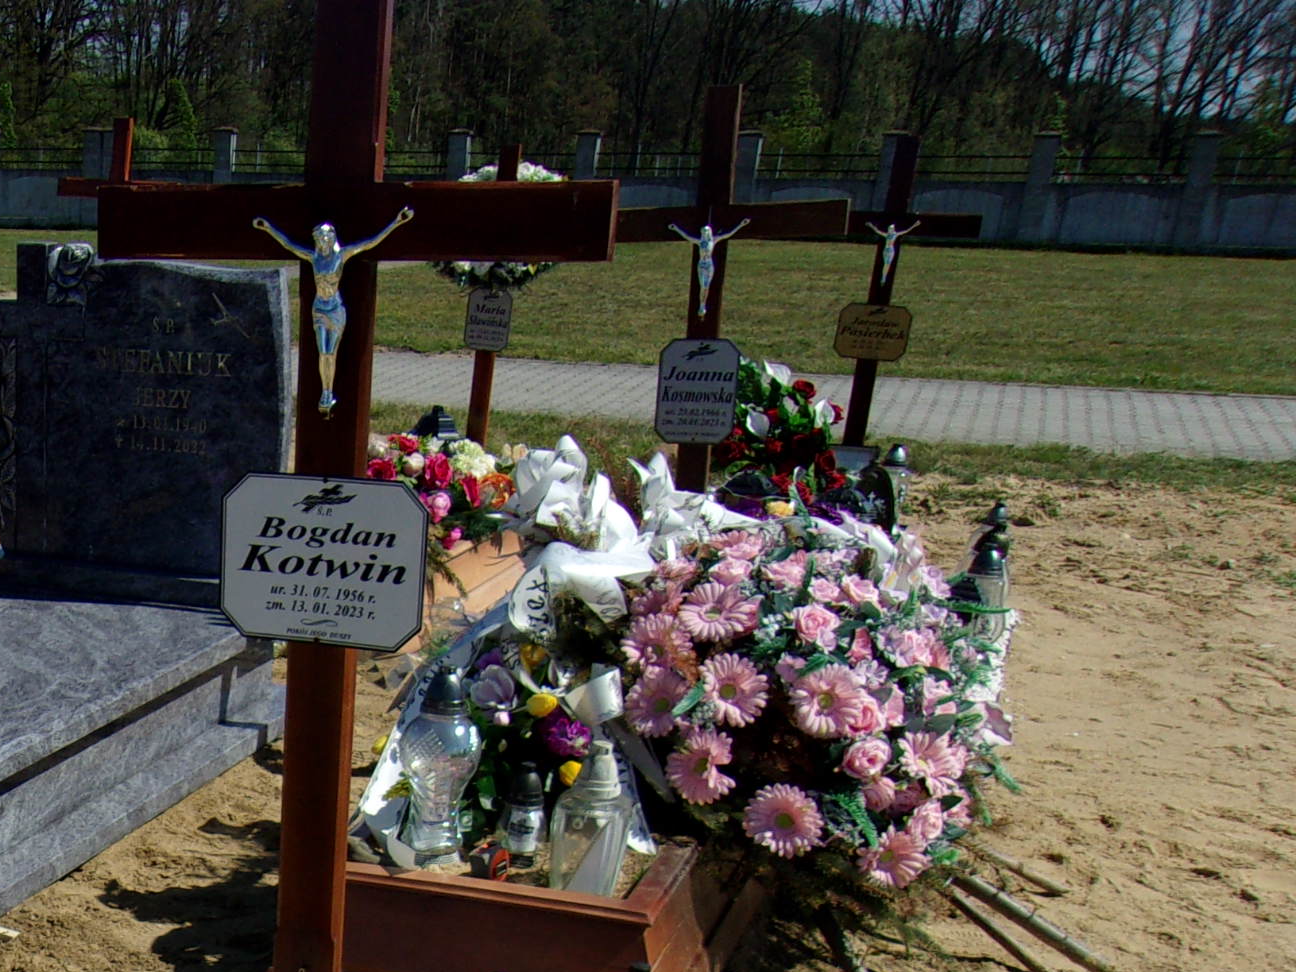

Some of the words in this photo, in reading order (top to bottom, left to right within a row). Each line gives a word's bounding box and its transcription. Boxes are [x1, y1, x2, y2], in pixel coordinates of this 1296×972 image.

[476, 303, 506, 315] Maria
[663, 366, 735, 382] Joanna
[134, 386, 193, 409] JERZY
[661, 385, 734, 404] Kosmowska
[256, 515, 398, 549] Bogdan
[238, 542, 407, 585] Kotwin
[270, 585, 286, 596] ur.
[290, 583, 308, 597] 31.
[313, 586, 330, 599] 07.
[335, 588, 365, 604] 1956
[367, 594, 377, 604] r.
[265, 600, 286, 611] zm.
[291, 599, 308, 613] 13.
[312, 602, 330, 615] 01.
[334, 604, 364, 618] 2023
[367, 609, 376, 620] r.
